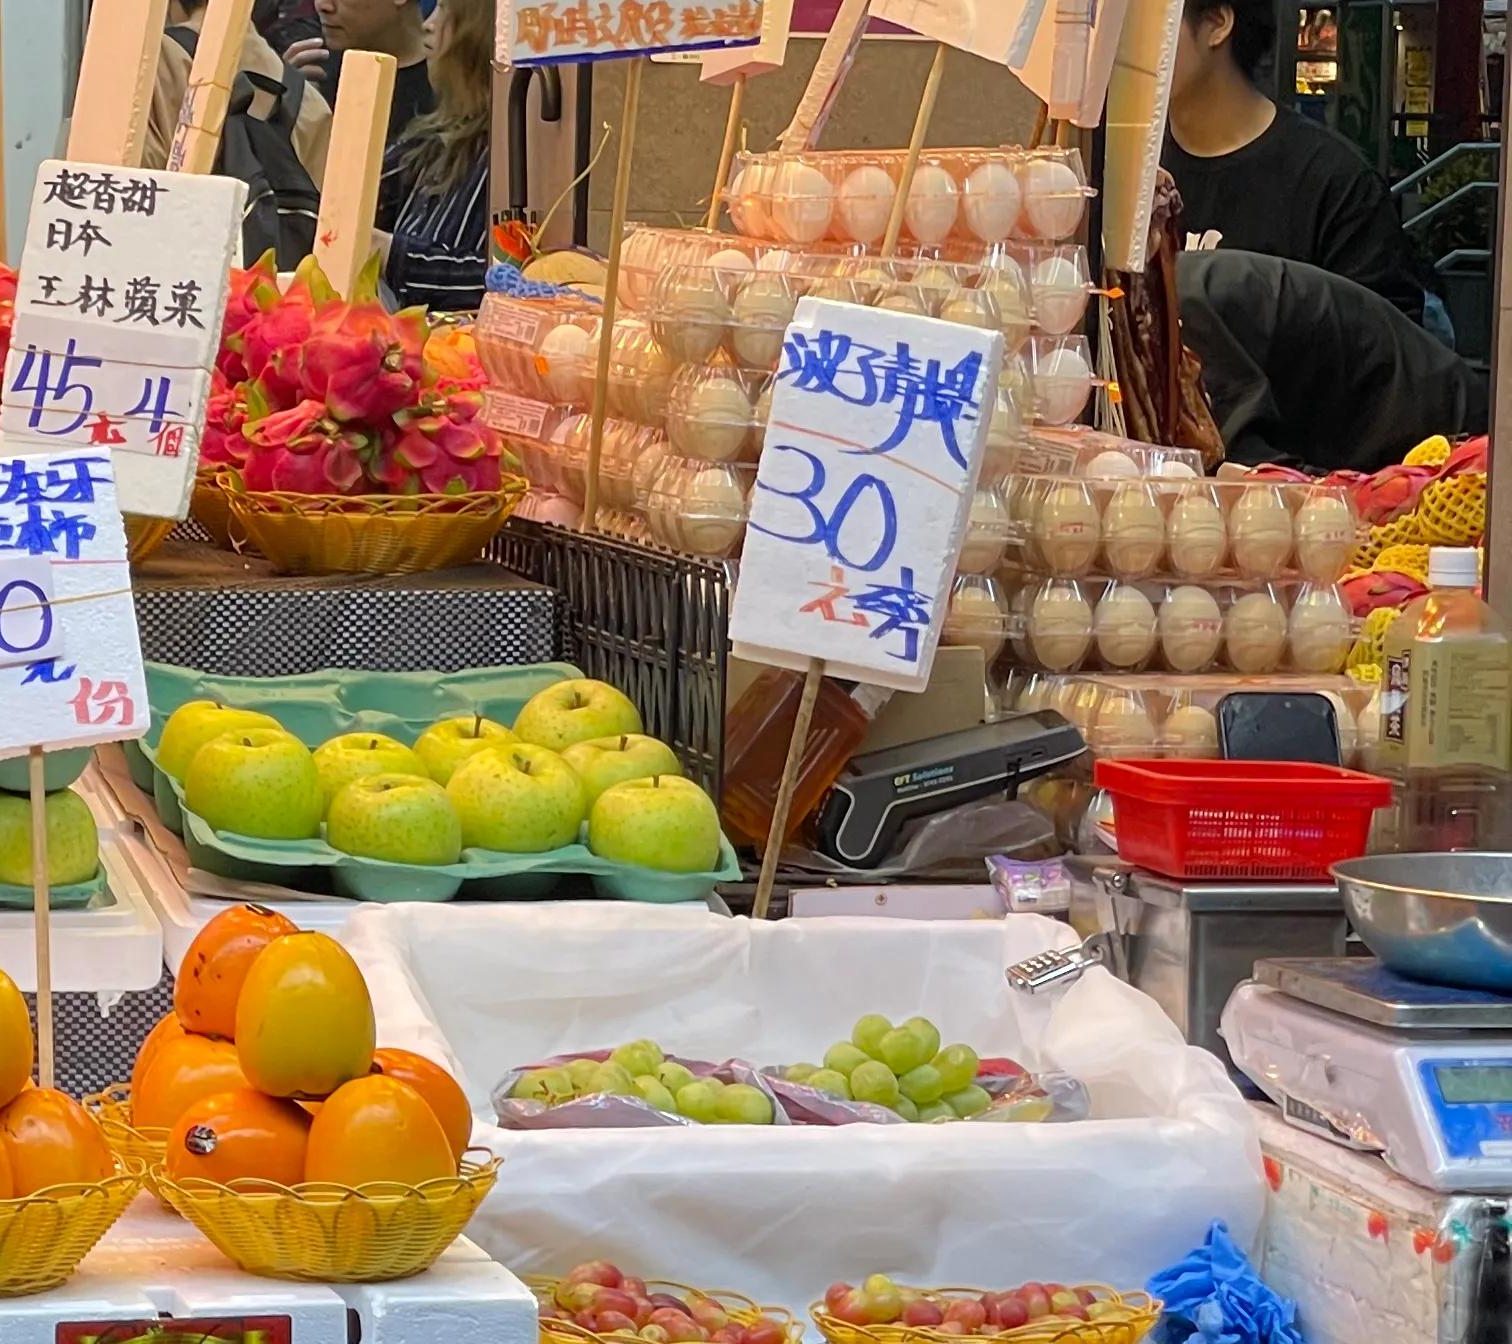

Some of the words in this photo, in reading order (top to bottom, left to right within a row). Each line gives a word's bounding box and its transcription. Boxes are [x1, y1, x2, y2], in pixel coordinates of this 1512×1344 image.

[43, 168, 169, 217] 超香甜
[47, 219, 112, 256] 日本
[10, 338, 103, 436] 45
[748, 444, 898, 573] 30
